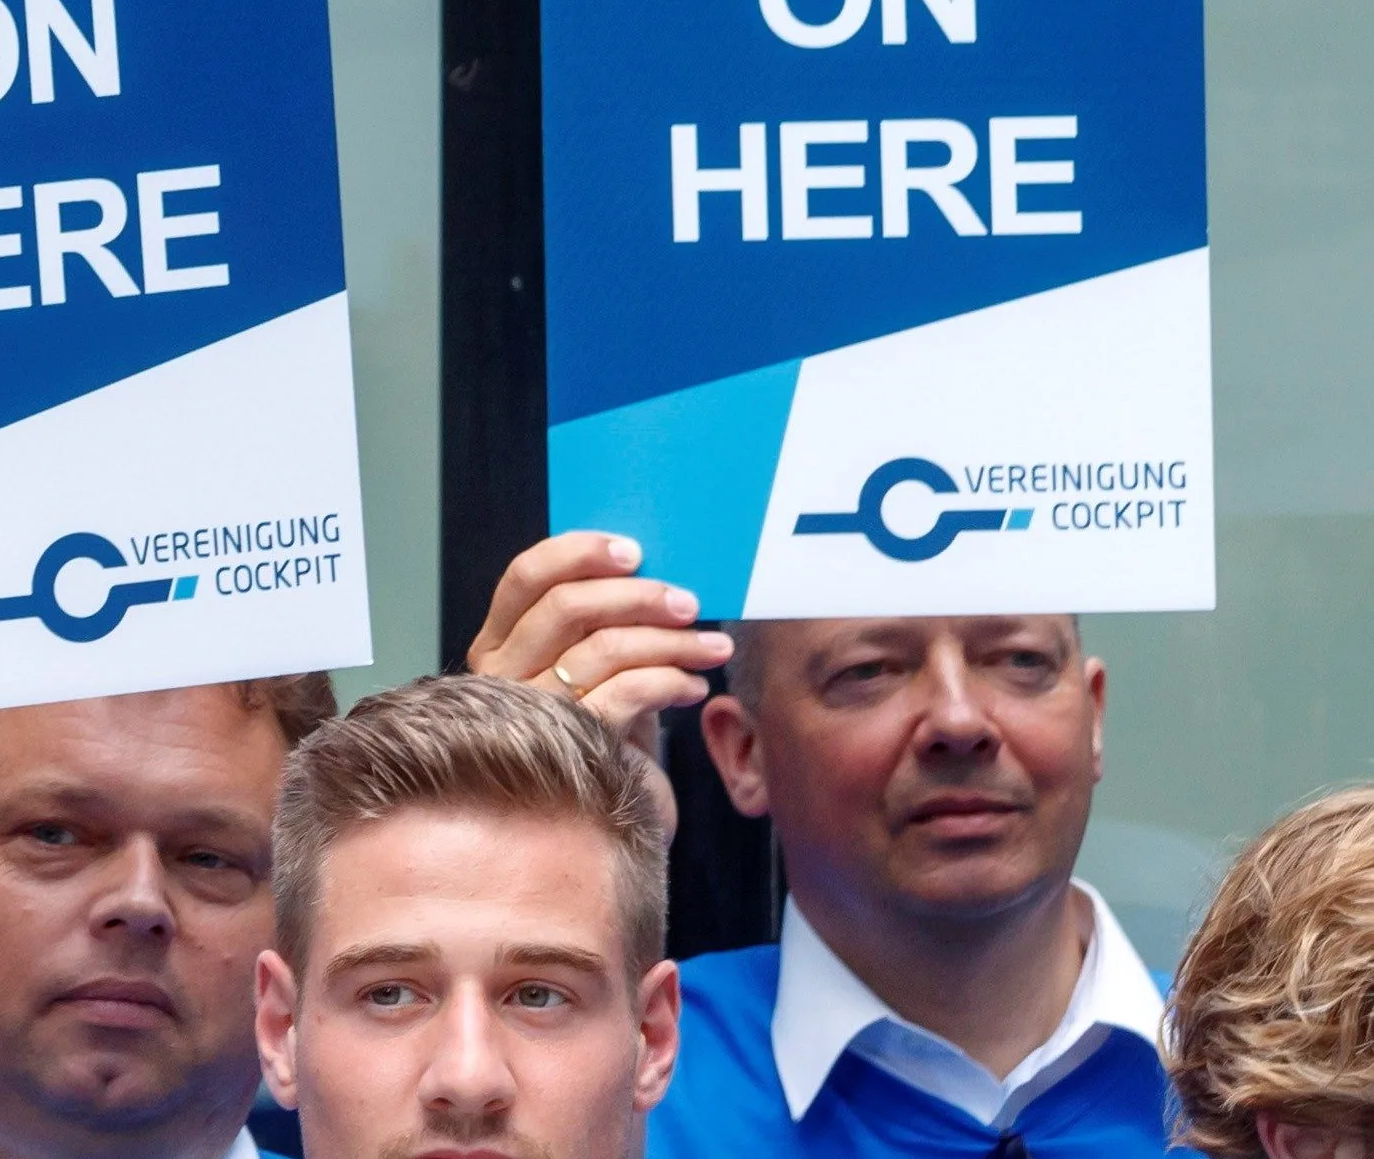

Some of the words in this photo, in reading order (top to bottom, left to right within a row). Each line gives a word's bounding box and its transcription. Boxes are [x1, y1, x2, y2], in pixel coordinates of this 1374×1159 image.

[672, 117, 1081, 241] HERE
[964, 461, 1186, 494] VEREINIGUNG
[1052, 500, 1186, 530] COCKPIT
[130, 514, 340, 565] VEREINIGUNG
[215, 553, 341, 595] COCKPIT
